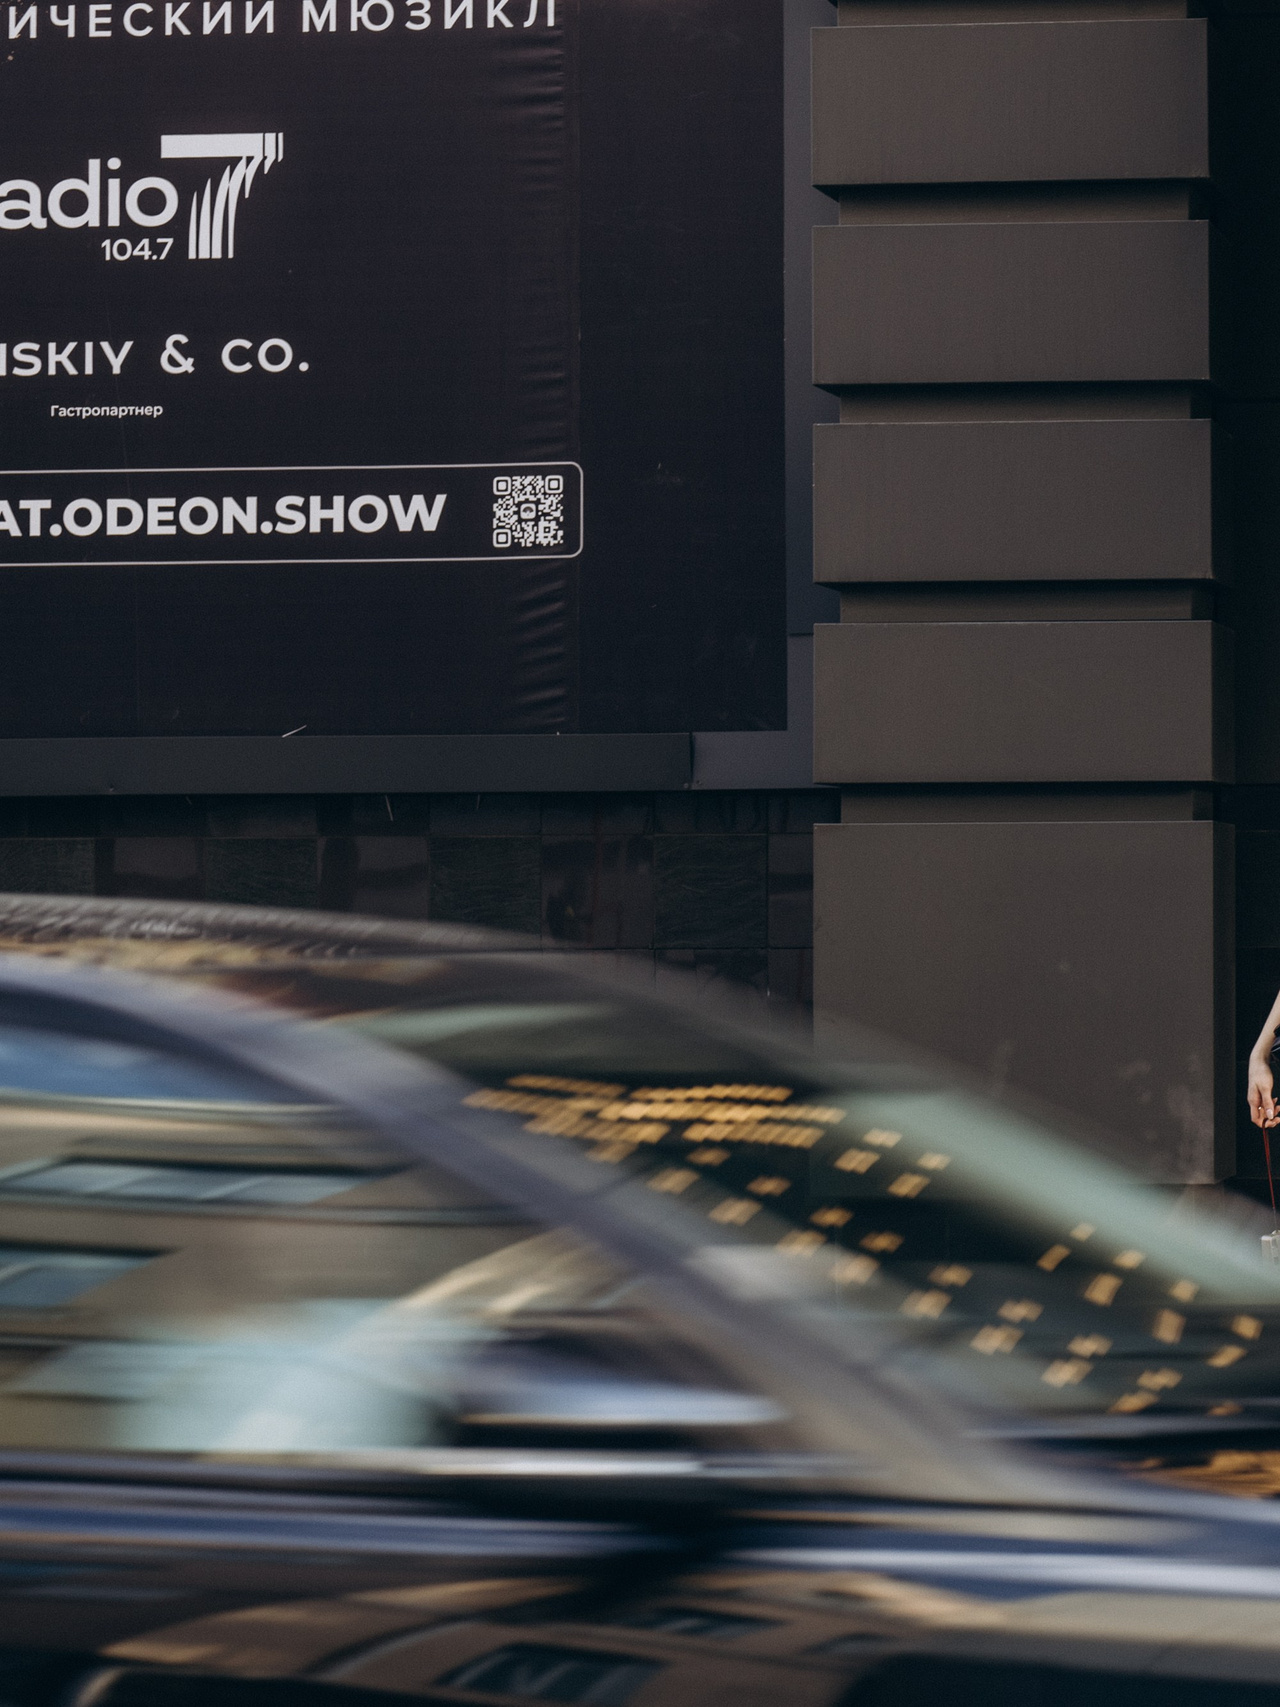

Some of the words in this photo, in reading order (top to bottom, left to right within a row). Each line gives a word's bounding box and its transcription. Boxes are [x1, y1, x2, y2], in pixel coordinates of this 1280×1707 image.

[302, 0, 555, 33] МЮЗИКЛ
[0, 157, 179, 230] adio
[161, 133, 284, 260] 7
[101, 238, 174, 261] 104.7
[0, 341, 134, 377] SKIY
[160, 333, 196, 375] &
[221, 337, 309, 374] CO.
[50, 404, 164, 420] Гастропартнер
